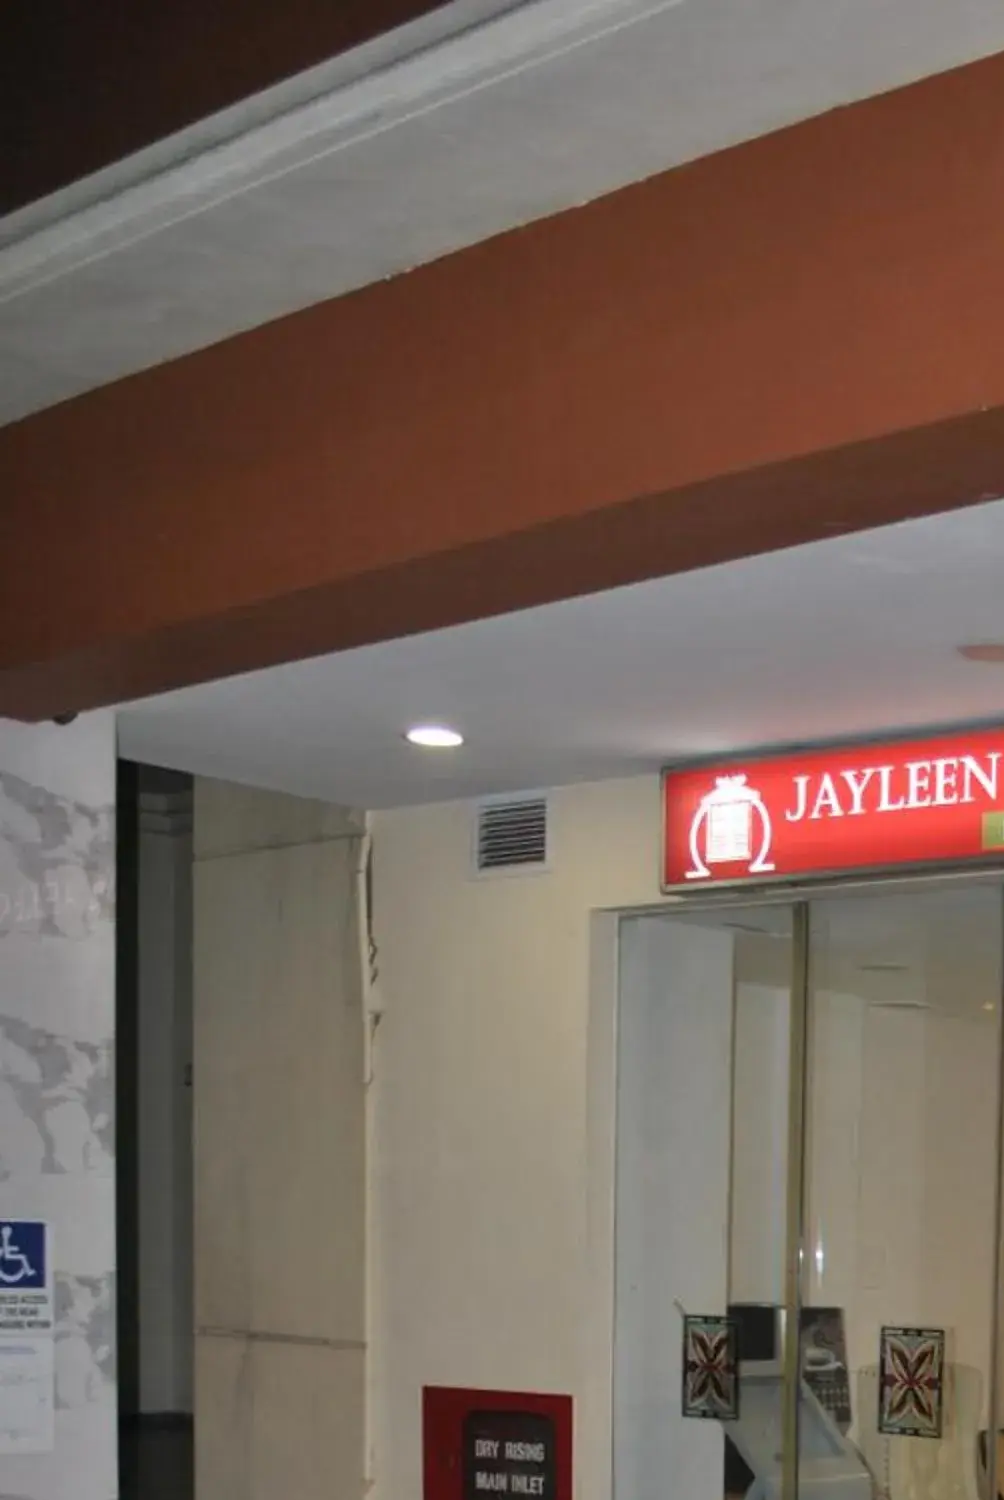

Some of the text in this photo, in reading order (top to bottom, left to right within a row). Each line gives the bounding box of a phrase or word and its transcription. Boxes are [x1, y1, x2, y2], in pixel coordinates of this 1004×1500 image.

[785, 752, 1003, 822] JAYLEEN
[475, 1439, 545, 1462] DRY RISING
[475, 1471, 544, 1495] MAIN INLET
